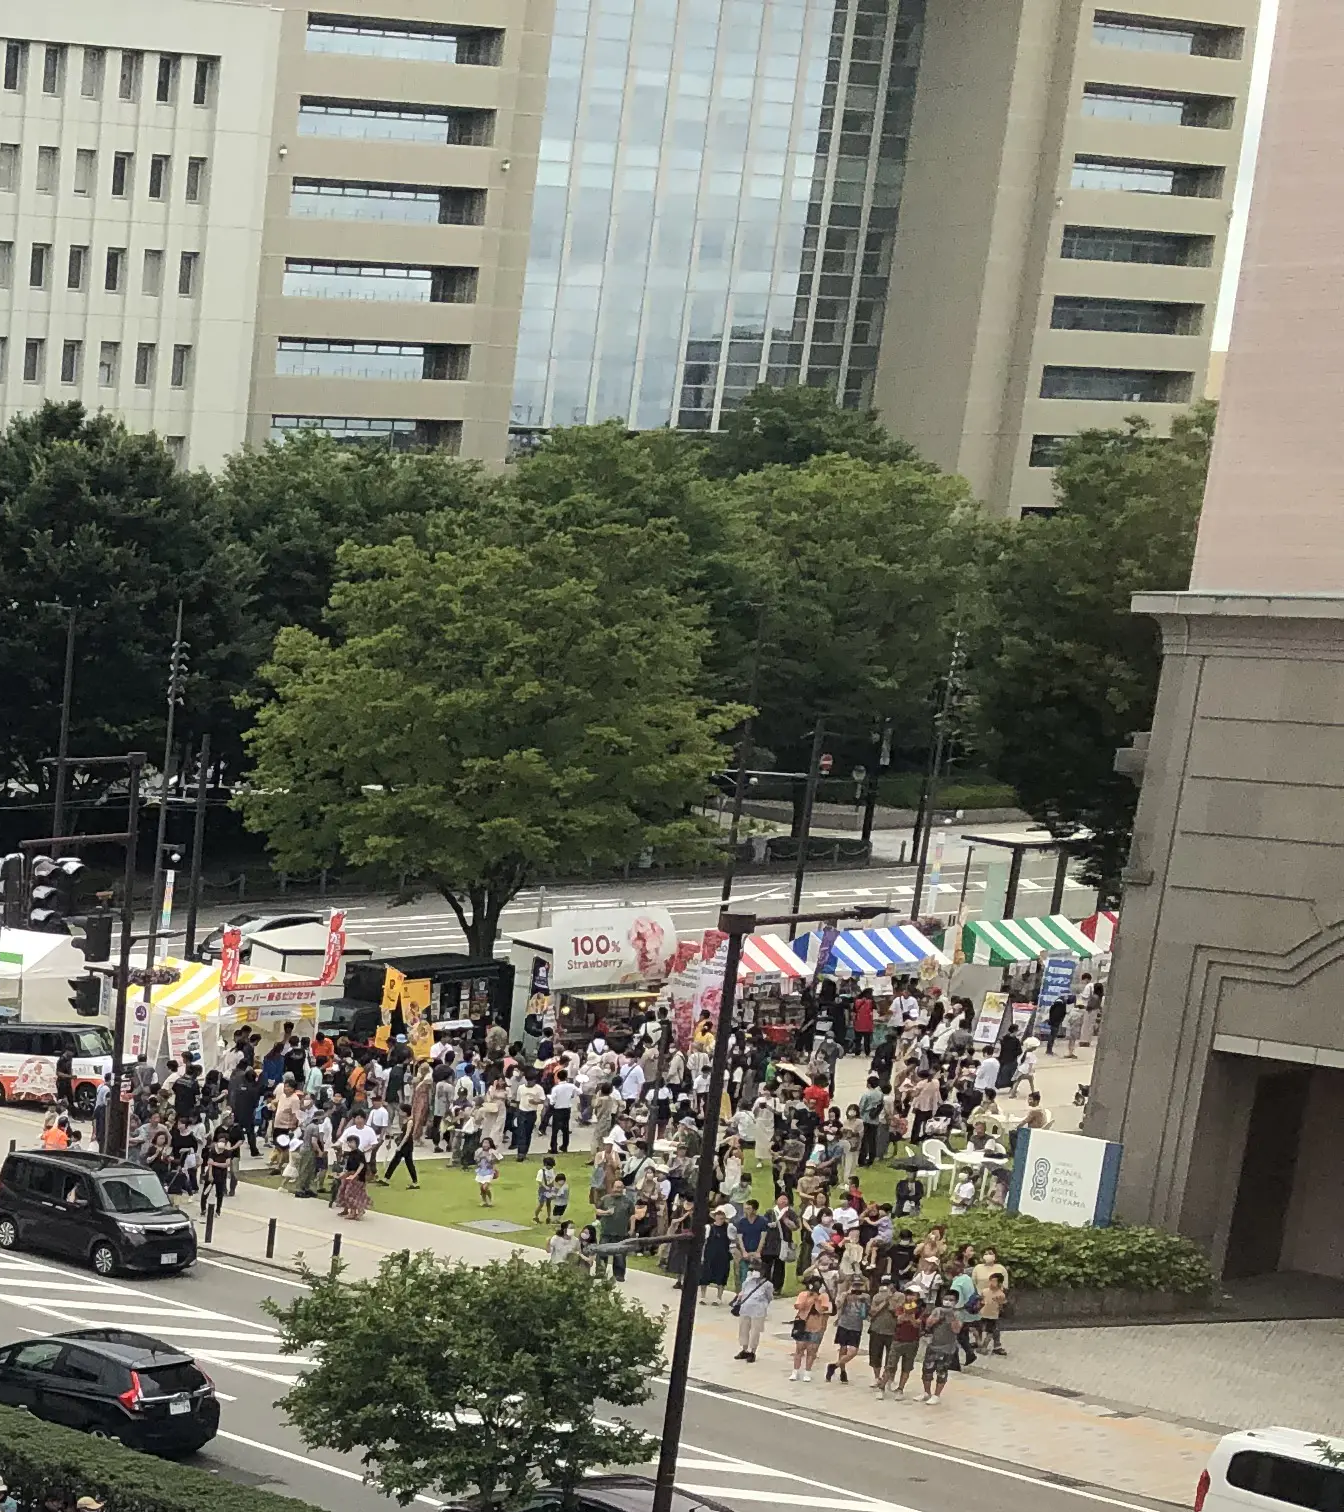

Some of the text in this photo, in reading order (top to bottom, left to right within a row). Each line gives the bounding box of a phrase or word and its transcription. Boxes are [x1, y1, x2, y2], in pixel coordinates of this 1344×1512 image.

[571, 934, 621, 956] 100%
[567, 958, 623, 970] Strawberry
[1051, 1177, 1075, 1187] PARK
[1051, 1188, 1079, 1198] HOTEL
[1051, 1196, 1086, 1208] TOYAMA
